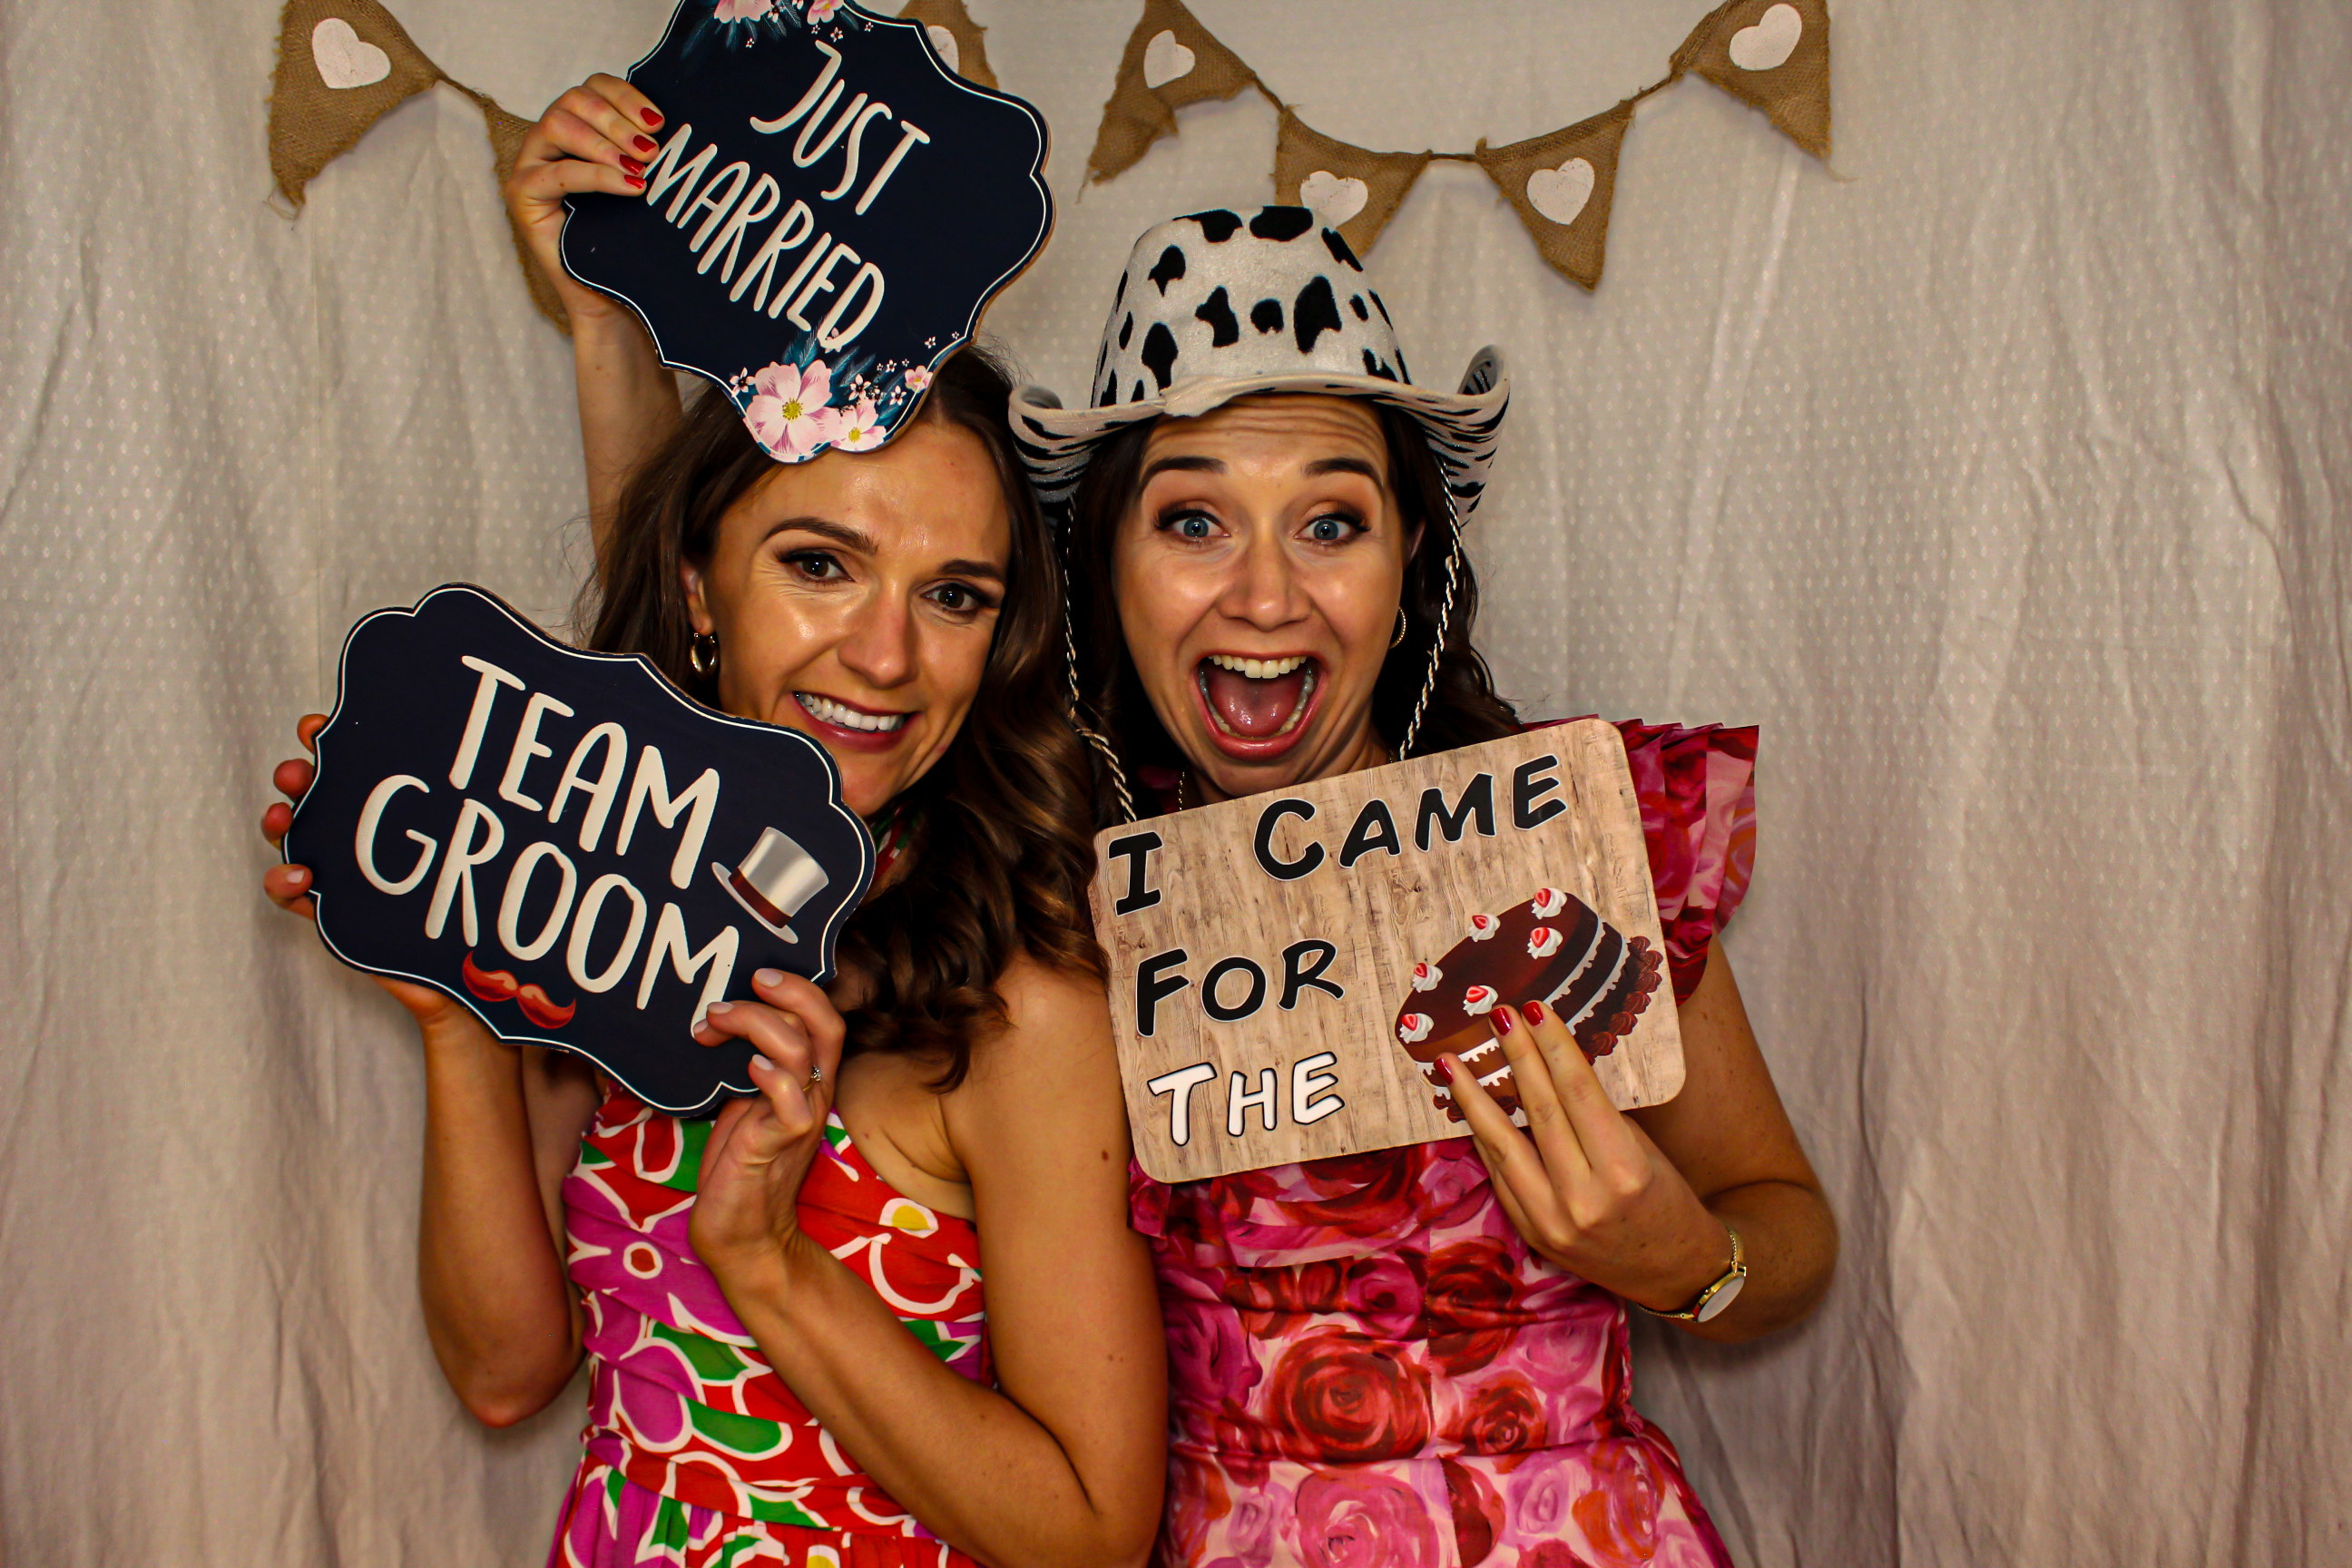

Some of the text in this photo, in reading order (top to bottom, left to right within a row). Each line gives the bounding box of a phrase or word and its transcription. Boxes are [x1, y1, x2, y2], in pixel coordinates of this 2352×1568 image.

[750, 40, 930, 215] JUST
[643, 123, 885, 349] MARRIED
[448, 655, 720, 889] TEAM
[1107, 754, 1567, 916] I CAME
[355, 774, 739, 1039] GROOM
[1135, 939, 1345, 1037] FOR
[1147, 1051, 1345, 1146] THE
